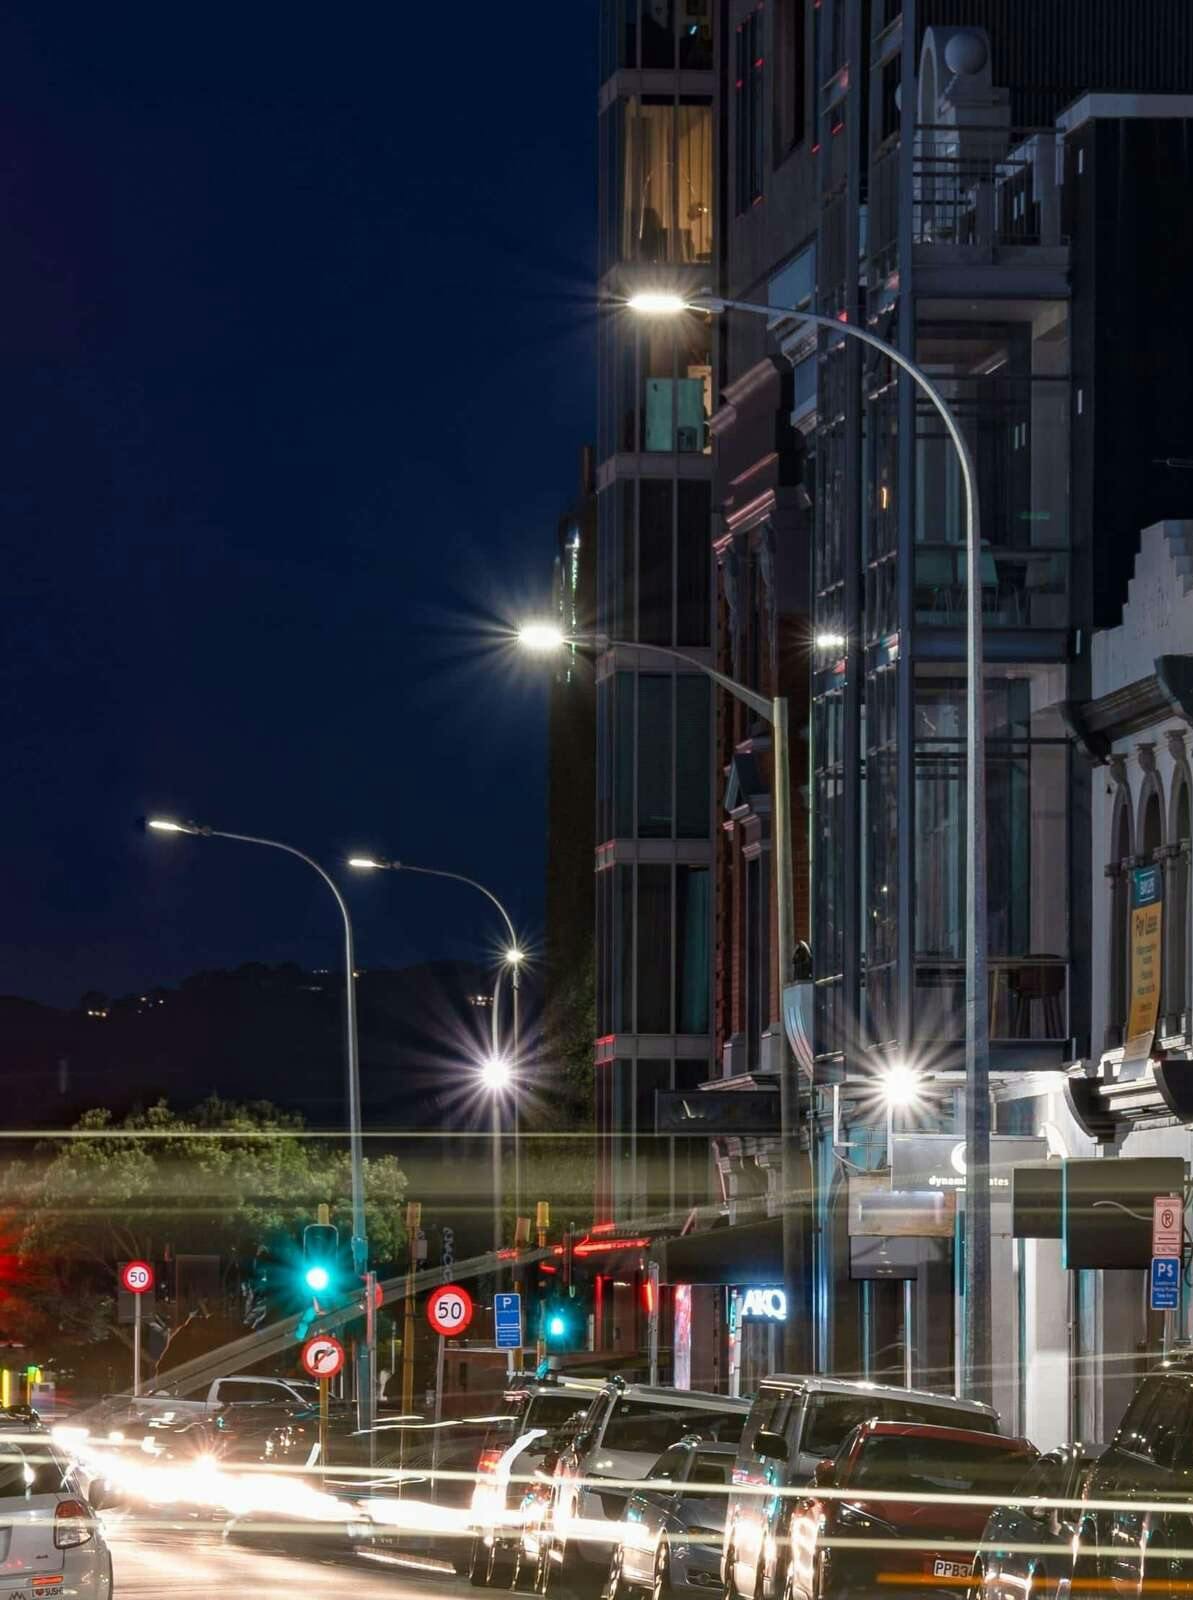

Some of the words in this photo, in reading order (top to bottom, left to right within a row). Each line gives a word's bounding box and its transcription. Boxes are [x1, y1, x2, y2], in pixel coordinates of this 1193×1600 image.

[928, 1175, 967, 1187] dynami
[989, 1177, 1009, 1186] ates
[130, 1271, 146, 1283] 50
[503, 1296, 512, 1309] P
[438, 1301, 462, 1320] 50
